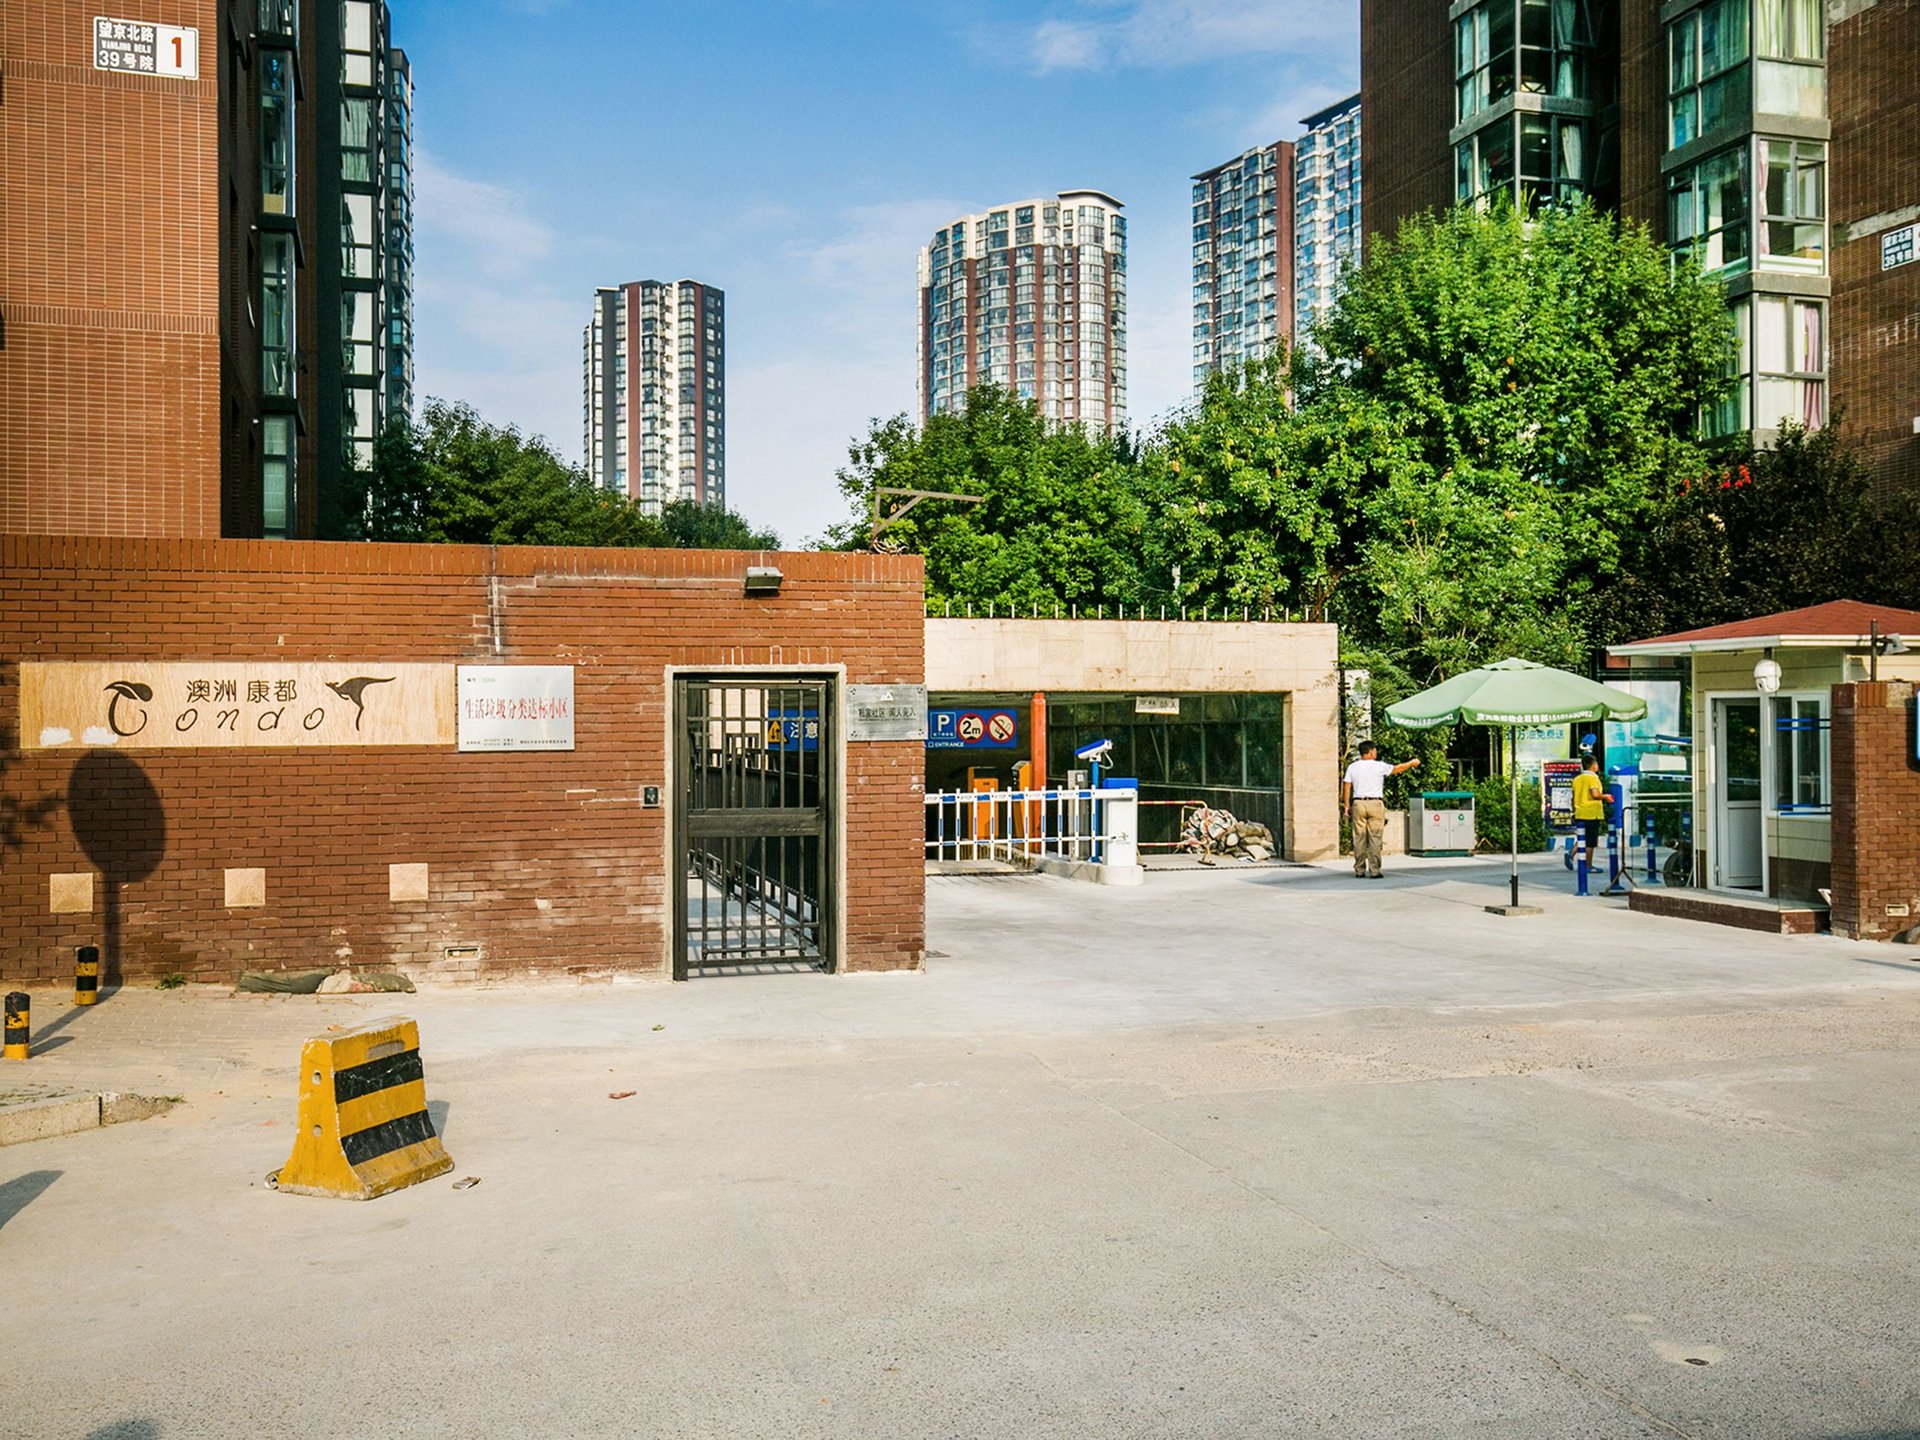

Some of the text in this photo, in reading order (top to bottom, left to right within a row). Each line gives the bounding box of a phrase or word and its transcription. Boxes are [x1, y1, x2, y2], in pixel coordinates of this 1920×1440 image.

[99, 21, 154, 43] 望京北路
[98, 50, 154, 71] 39号院
[171, 37, 181, 68] 1
[187, 680, 296, 702] 澳洲康都
[938, 715, 950, 732] P
[963, 720, 980, 735] 2m
